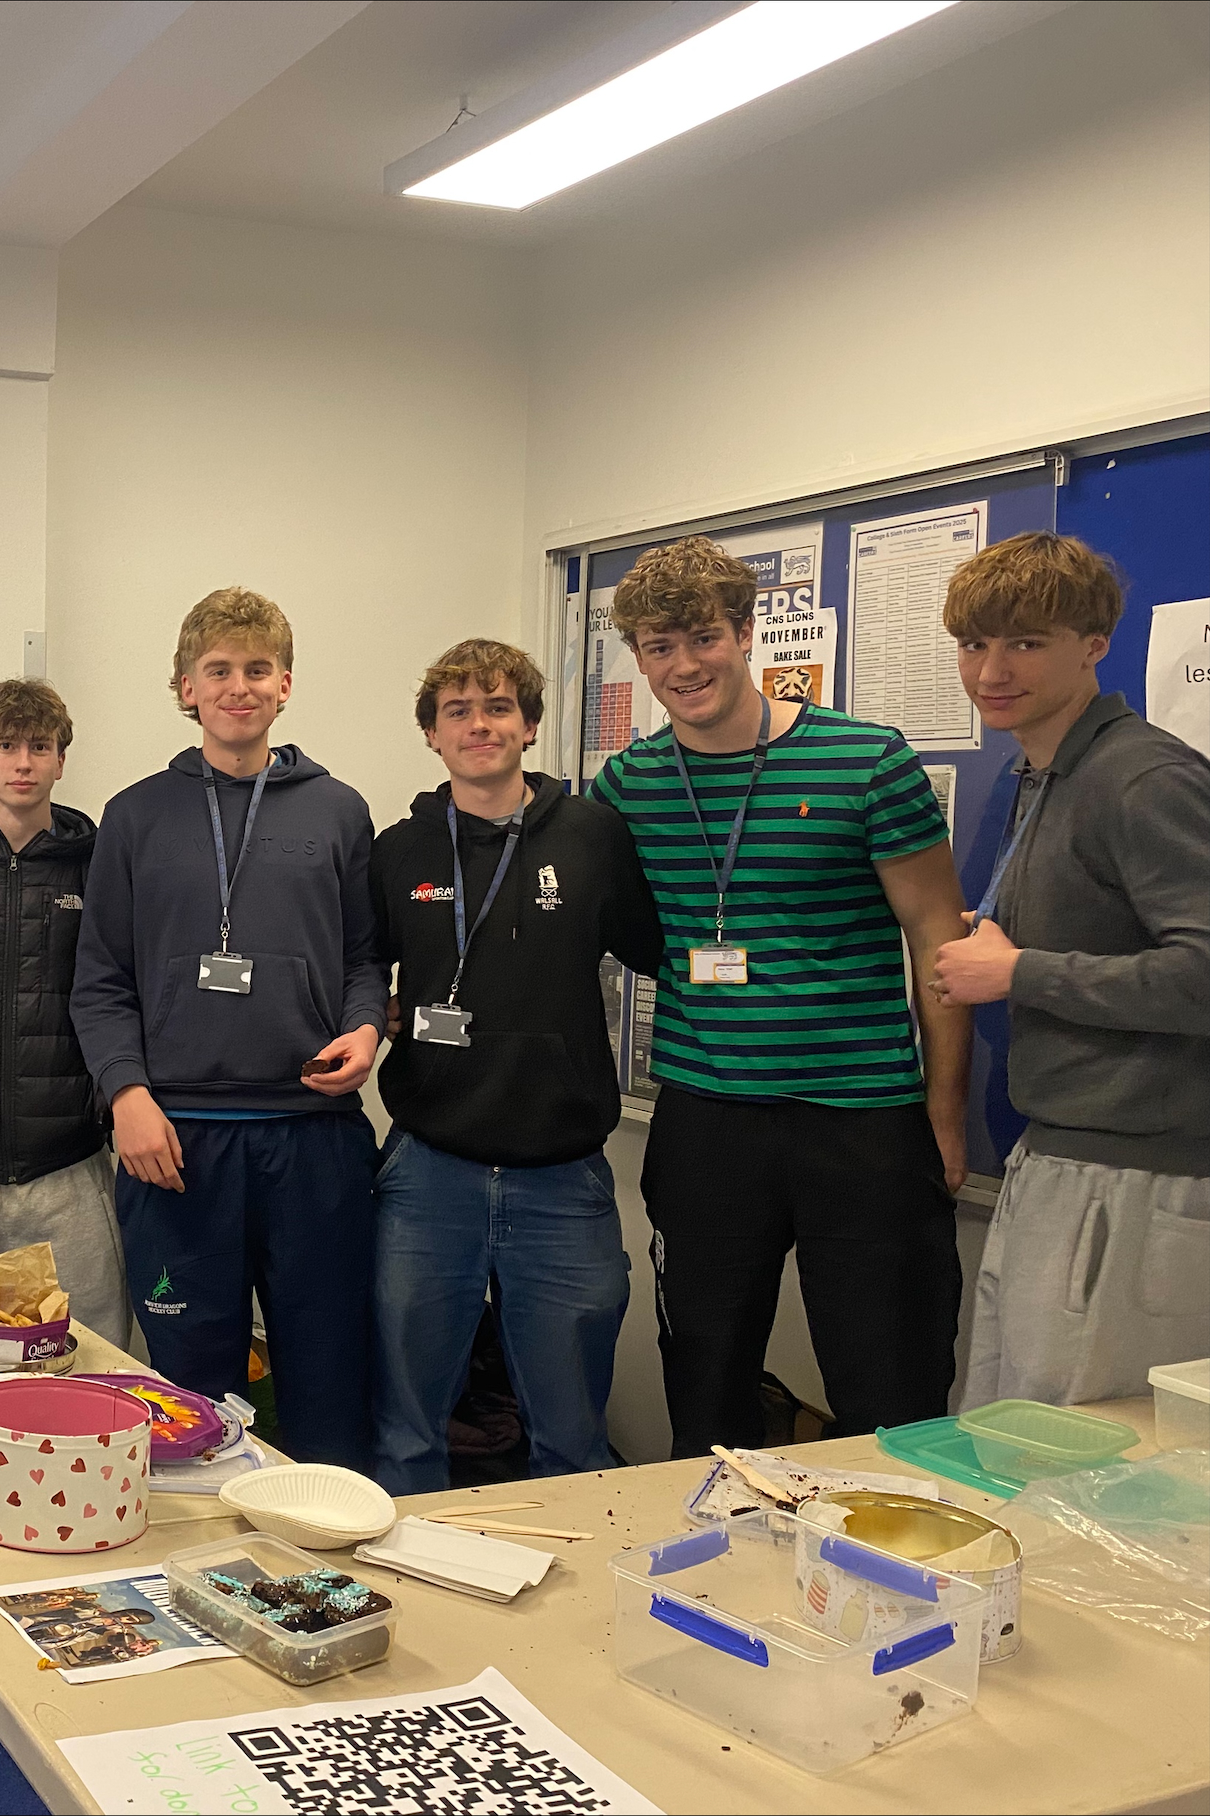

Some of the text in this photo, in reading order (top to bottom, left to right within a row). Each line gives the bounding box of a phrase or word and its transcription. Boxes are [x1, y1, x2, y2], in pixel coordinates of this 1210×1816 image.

[867, 534, 885, 542] College
[890, 530, 903, 538] Sixth
[903, 528, 917, 536] Form
[917, 525, 932, 534] Open
[933, 522, 951, 530] Events
[952, 519, 967, 527] 2025
[590, 607, 609, 620] YOU
[765, 612, 814, 625] CNS LIONS
[590, 620, 601, 632] UR
[773, 649, 812, 662] BAKE SALE
[410, 886, 455, 900] SAMURAI
[636, 990, 656, 1002] CAREE
[636, 1001, 655, 1013] DISCO
[28, 1340, 60, 1357] Quality
[127, 1751, 185, 1782] for
[176, 1735, 260, 1813] Link to
